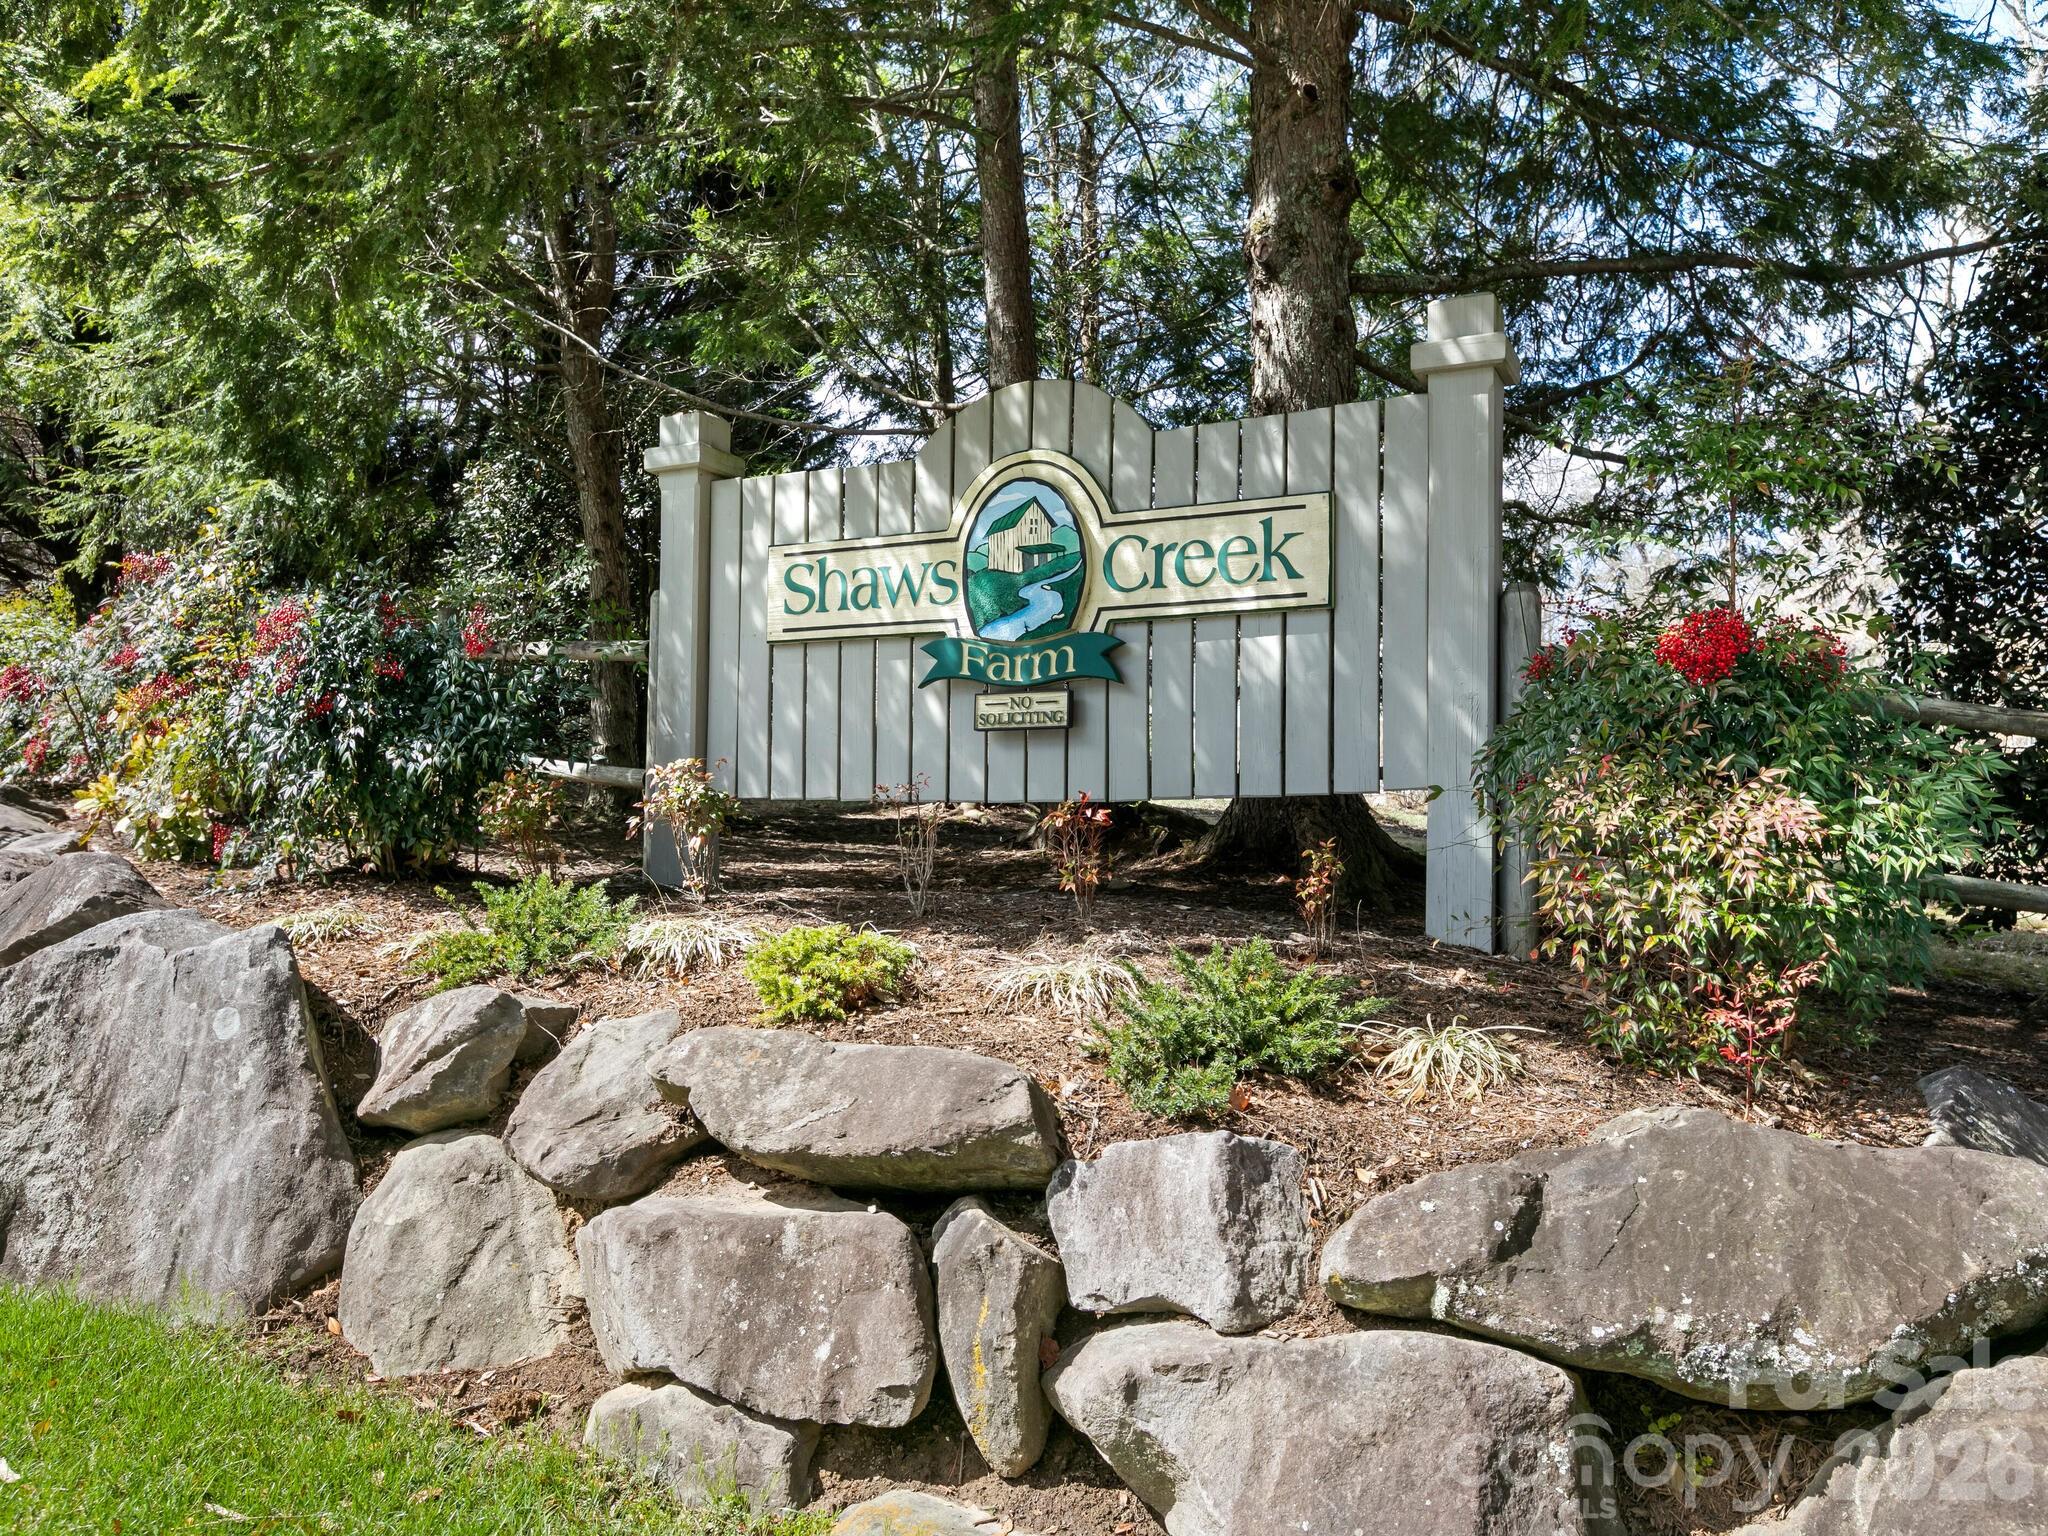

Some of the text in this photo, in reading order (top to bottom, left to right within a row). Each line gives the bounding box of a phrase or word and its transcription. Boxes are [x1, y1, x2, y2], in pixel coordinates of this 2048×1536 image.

[783, 517, 1304, 615] Shaws Creek
[959, 640, 1076, 682] Farm
[1009, 696, 1032, 710] NO
[979, 710, 1064, 726] SOLICITING
